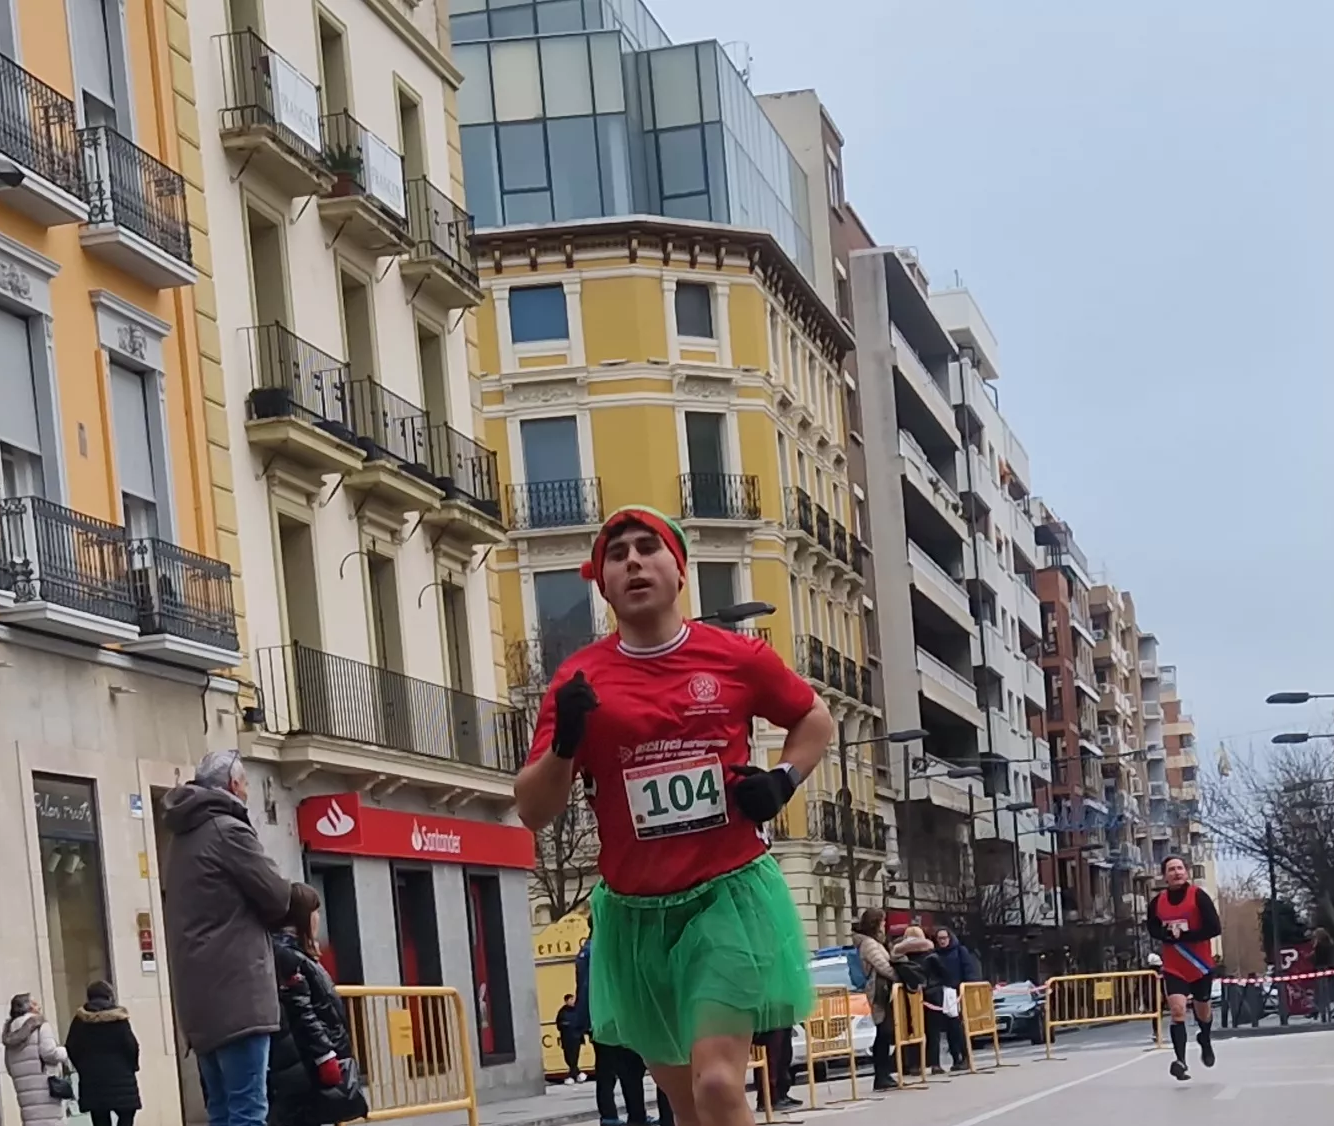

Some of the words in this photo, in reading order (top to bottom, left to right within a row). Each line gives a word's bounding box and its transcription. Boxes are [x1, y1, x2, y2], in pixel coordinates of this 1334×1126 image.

[642, 769, 720, 817] 104
[421, 825, 461, 854] Santander
[538, 939, 572, 955] ería
